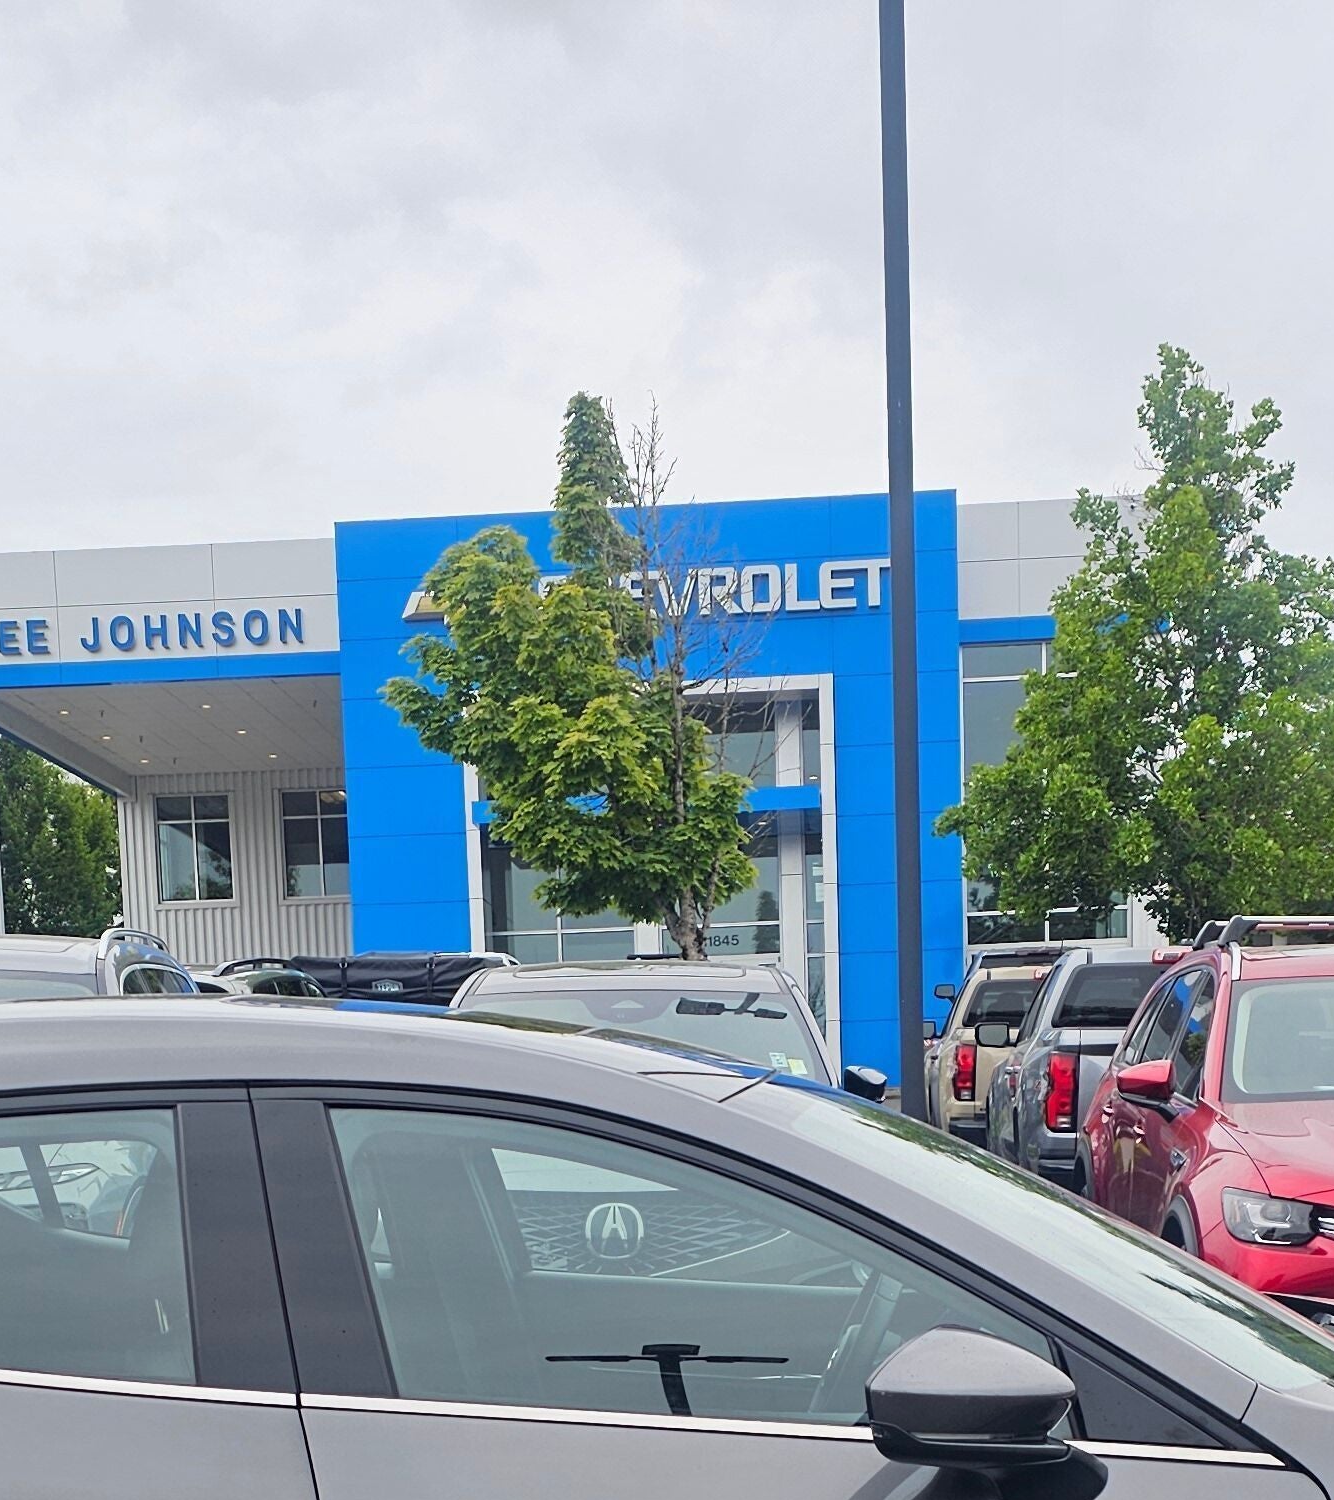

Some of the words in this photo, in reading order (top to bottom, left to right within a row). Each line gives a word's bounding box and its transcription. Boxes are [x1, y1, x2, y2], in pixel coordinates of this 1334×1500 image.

[538, 558, 892, 617] EVROLET
[80, 608, 304, 653] JOHNSON
[704, 934, 740, 948] 1845
